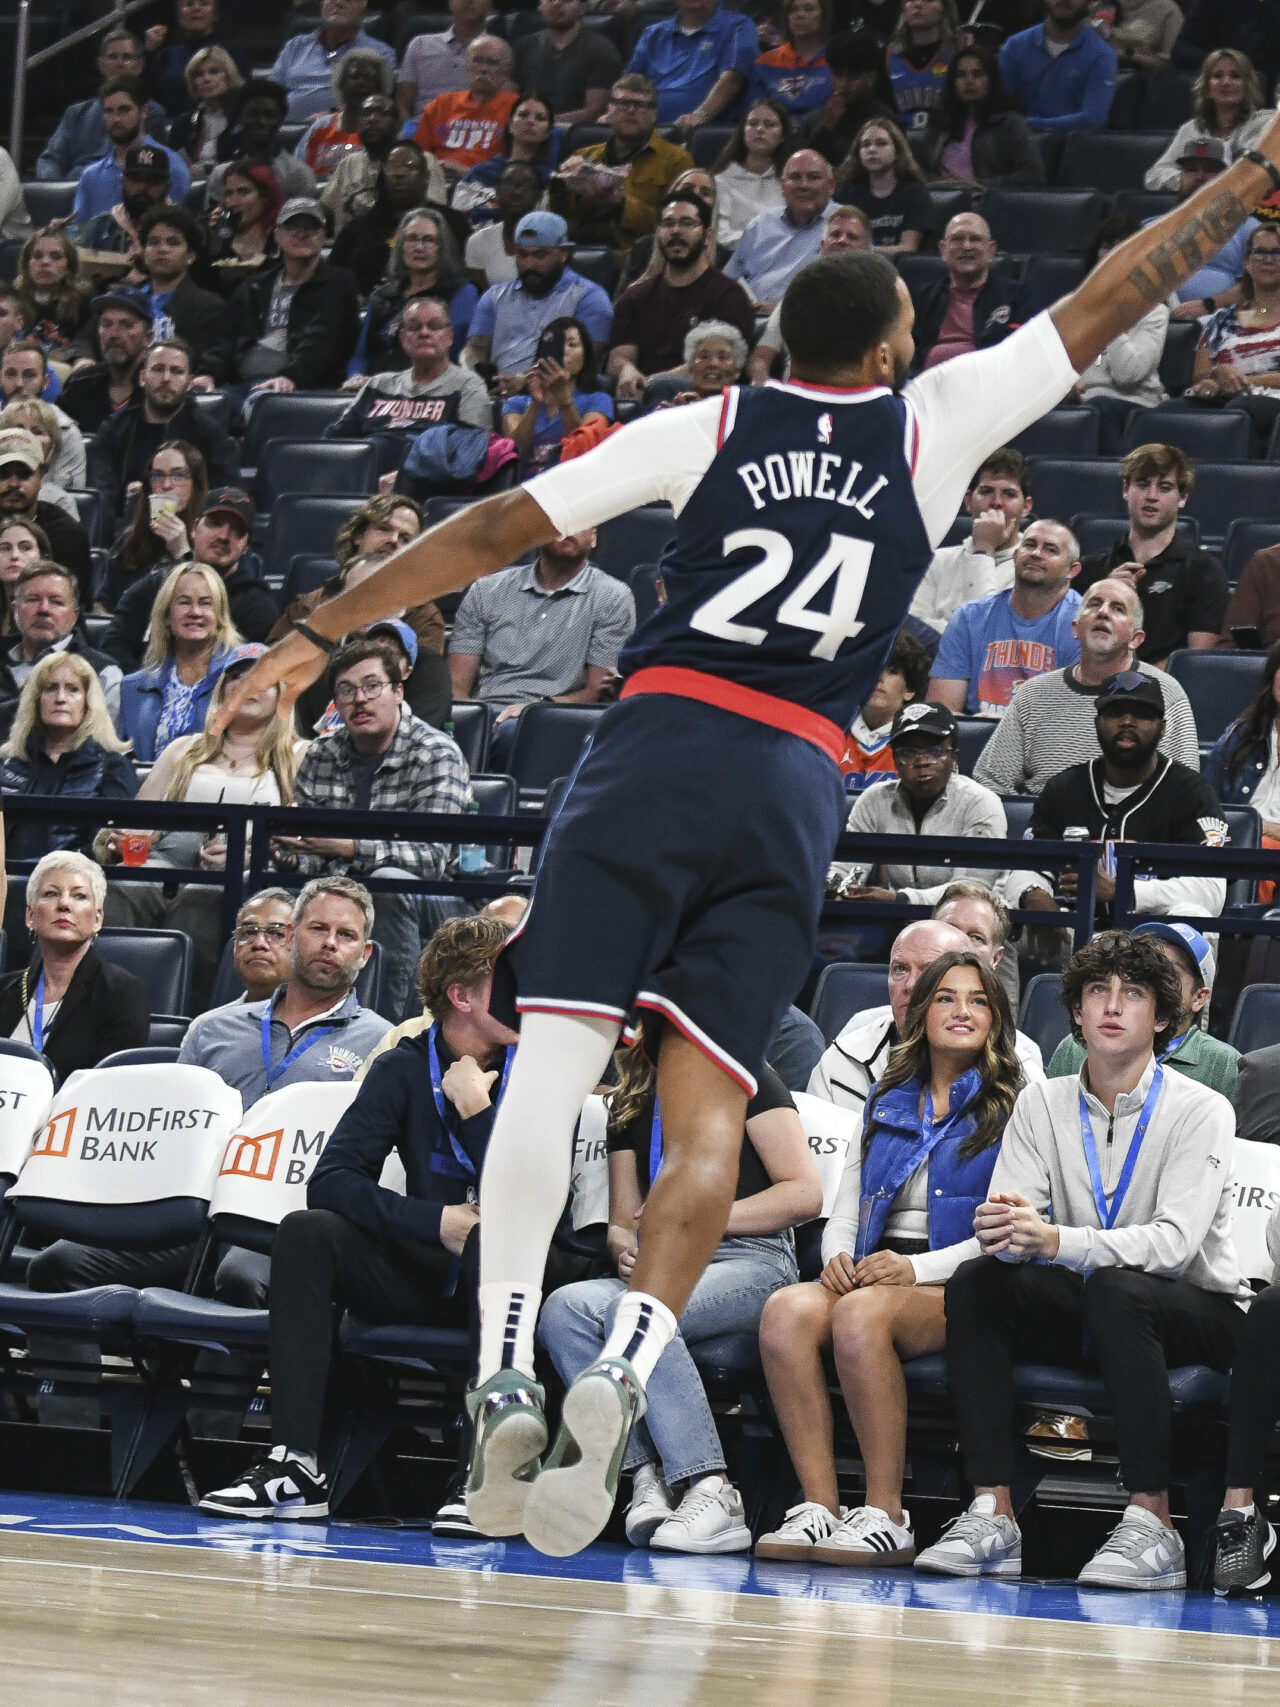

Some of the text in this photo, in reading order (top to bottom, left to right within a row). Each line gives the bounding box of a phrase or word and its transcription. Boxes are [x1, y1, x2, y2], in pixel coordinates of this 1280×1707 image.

[445, 130, 495, 149] UP!
[367, 399, 446, 422] THUNDER
[737, 451, 889, 520] POWELL
[689, 527, 876, 662] 24
[1197, 816, 1229, 834] THUNDER
[329, 1045, 364, 1068] THUNDER
